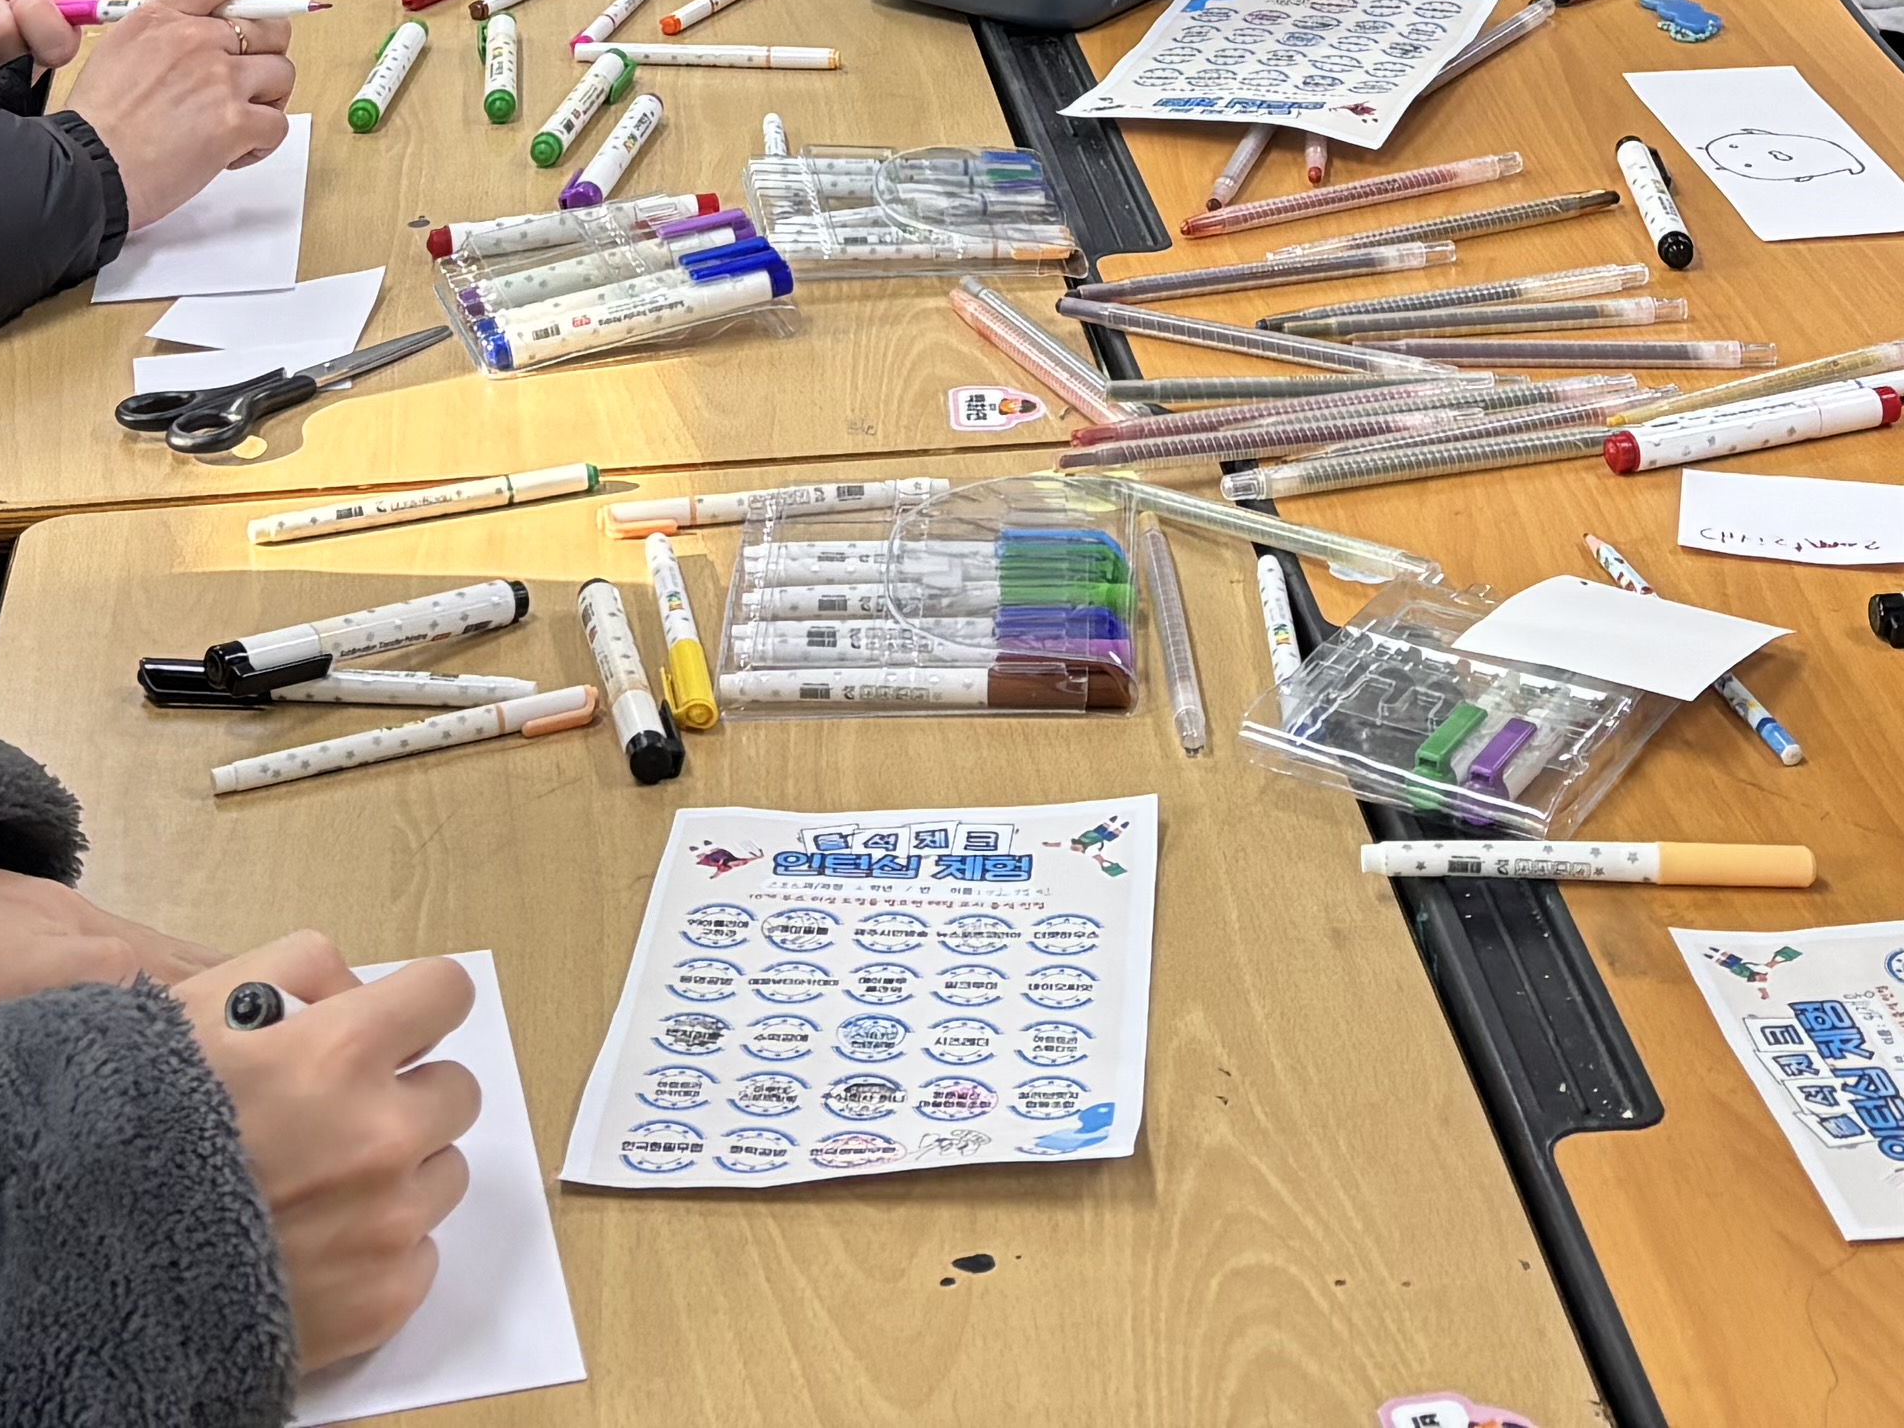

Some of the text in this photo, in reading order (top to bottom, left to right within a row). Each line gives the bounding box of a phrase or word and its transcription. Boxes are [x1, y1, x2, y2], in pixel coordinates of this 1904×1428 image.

[772, 851, 1034, 882] 인턴십 체험
[1787, 1000, 1874, 1060] 체험
